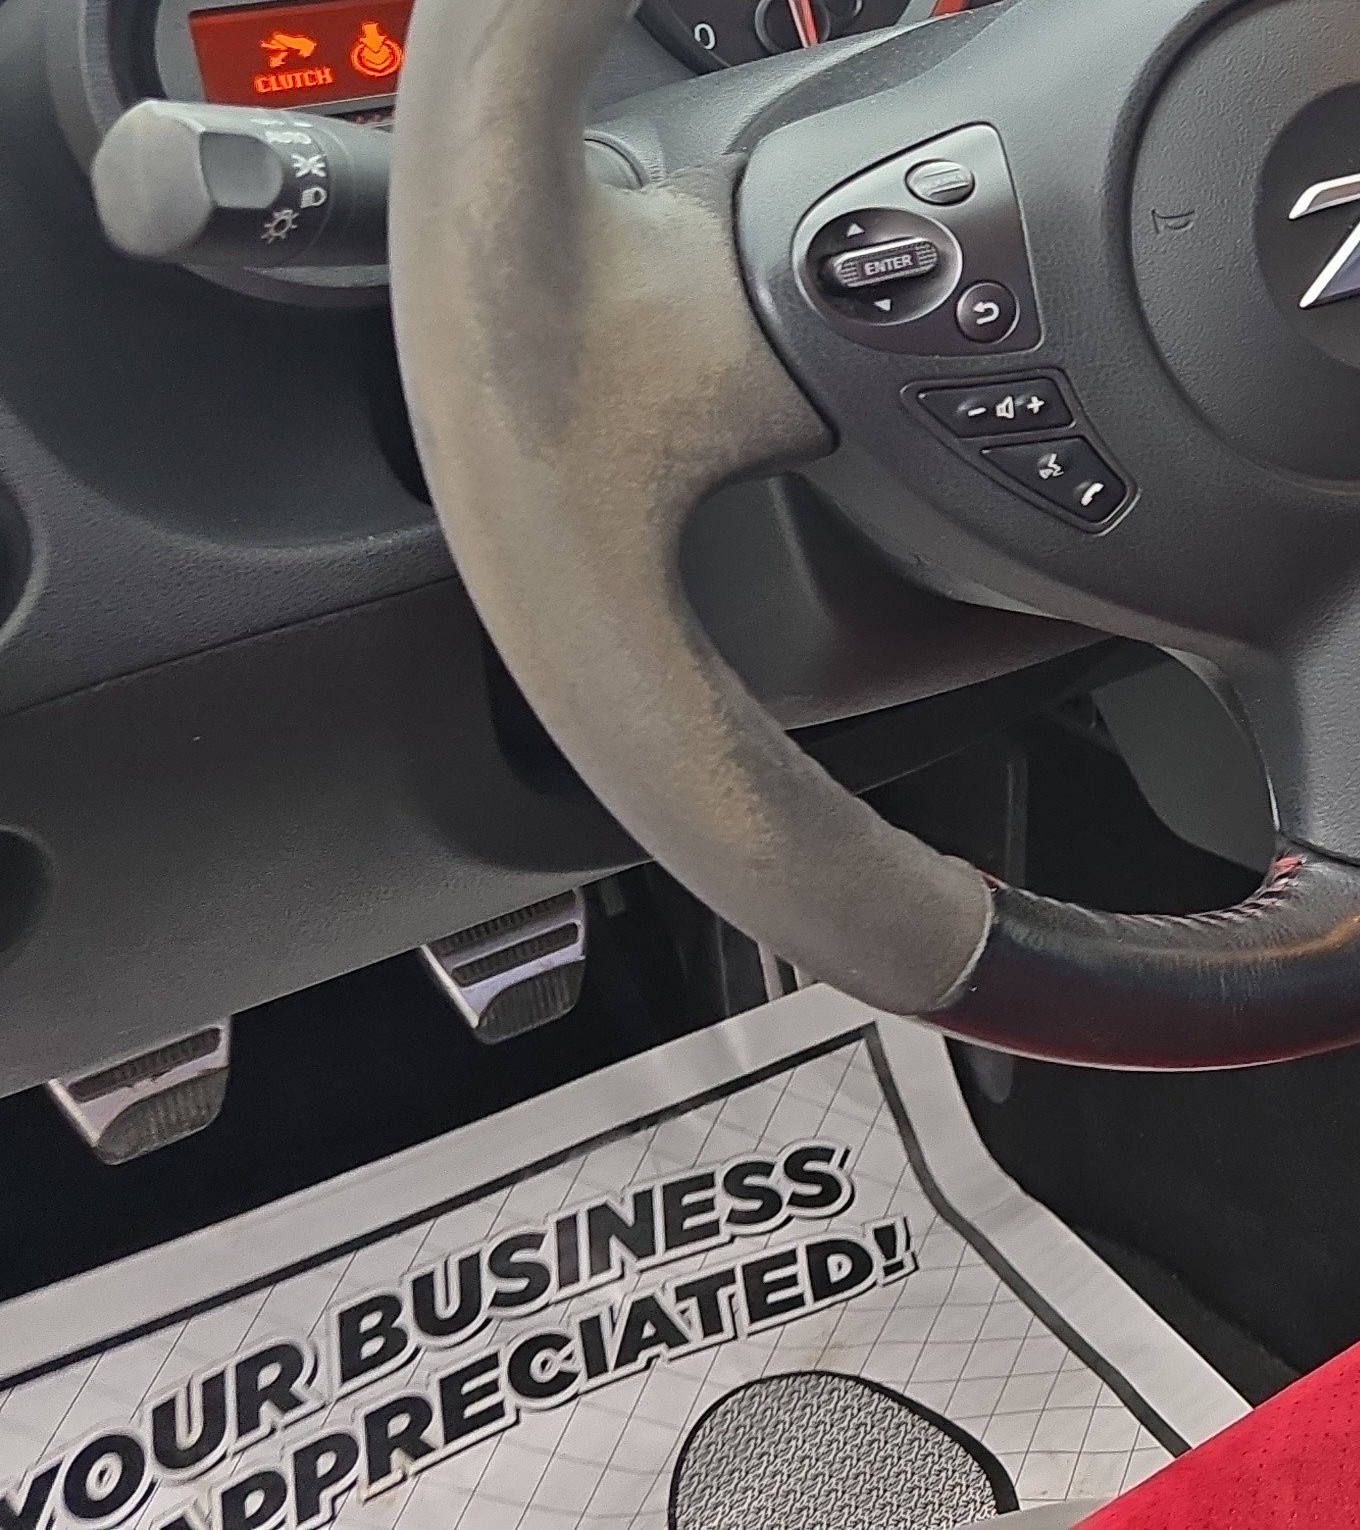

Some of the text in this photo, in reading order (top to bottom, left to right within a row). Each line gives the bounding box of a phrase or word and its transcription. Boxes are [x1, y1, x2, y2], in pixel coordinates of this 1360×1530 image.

[256, 68, 333, 93] CLUTCH
[864, 253, 914, 277] ENTER
[0, 1145, 848, 1530] YOUR BUSINESS
[158, 1222, 905, 1530] PPRECIATED!
